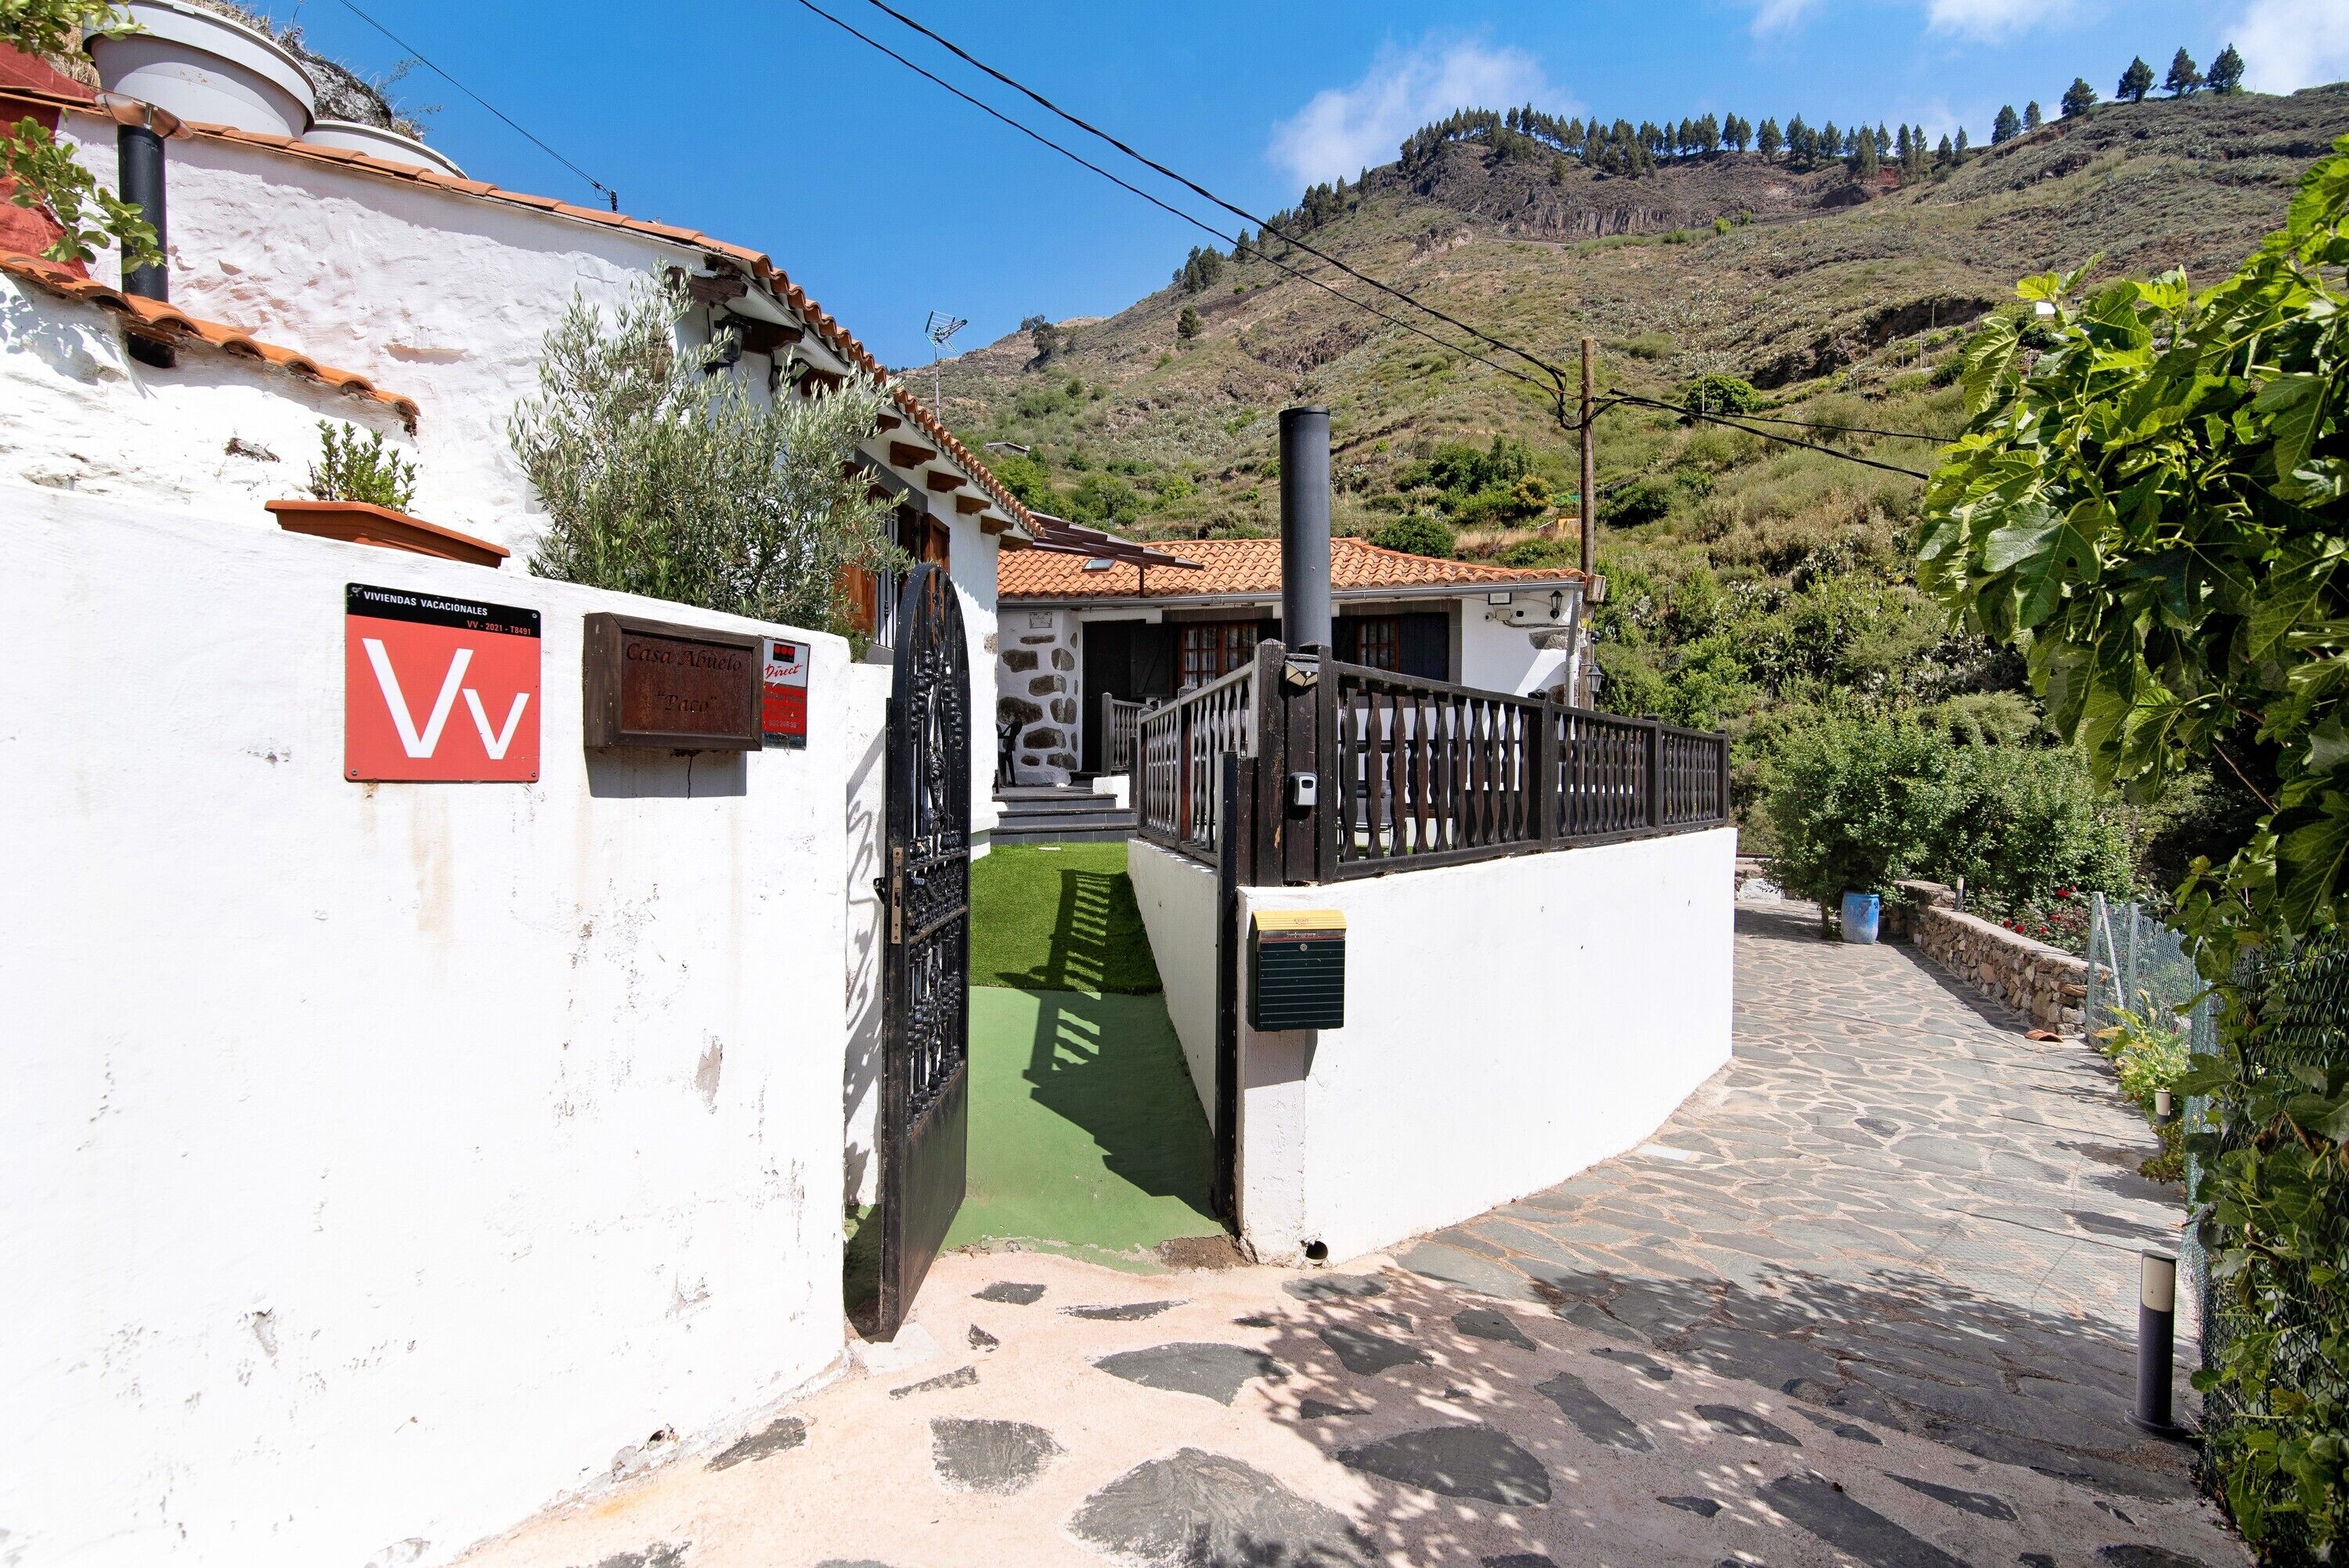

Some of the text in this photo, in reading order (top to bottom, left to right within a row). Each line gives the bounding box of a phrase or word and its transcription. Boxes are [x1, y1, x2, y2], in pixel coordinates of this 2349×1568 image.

[363, 591, 489, 616] VIVIENDAS VACACIONALES
[467, 619, 479, 629] VV
[485, 622, 503, 632] 2021
[510, 625, 531, 636] T8491
[626, 643, 742, 672] Casa Abuelo
[764, 663, 804, 679] Direct
